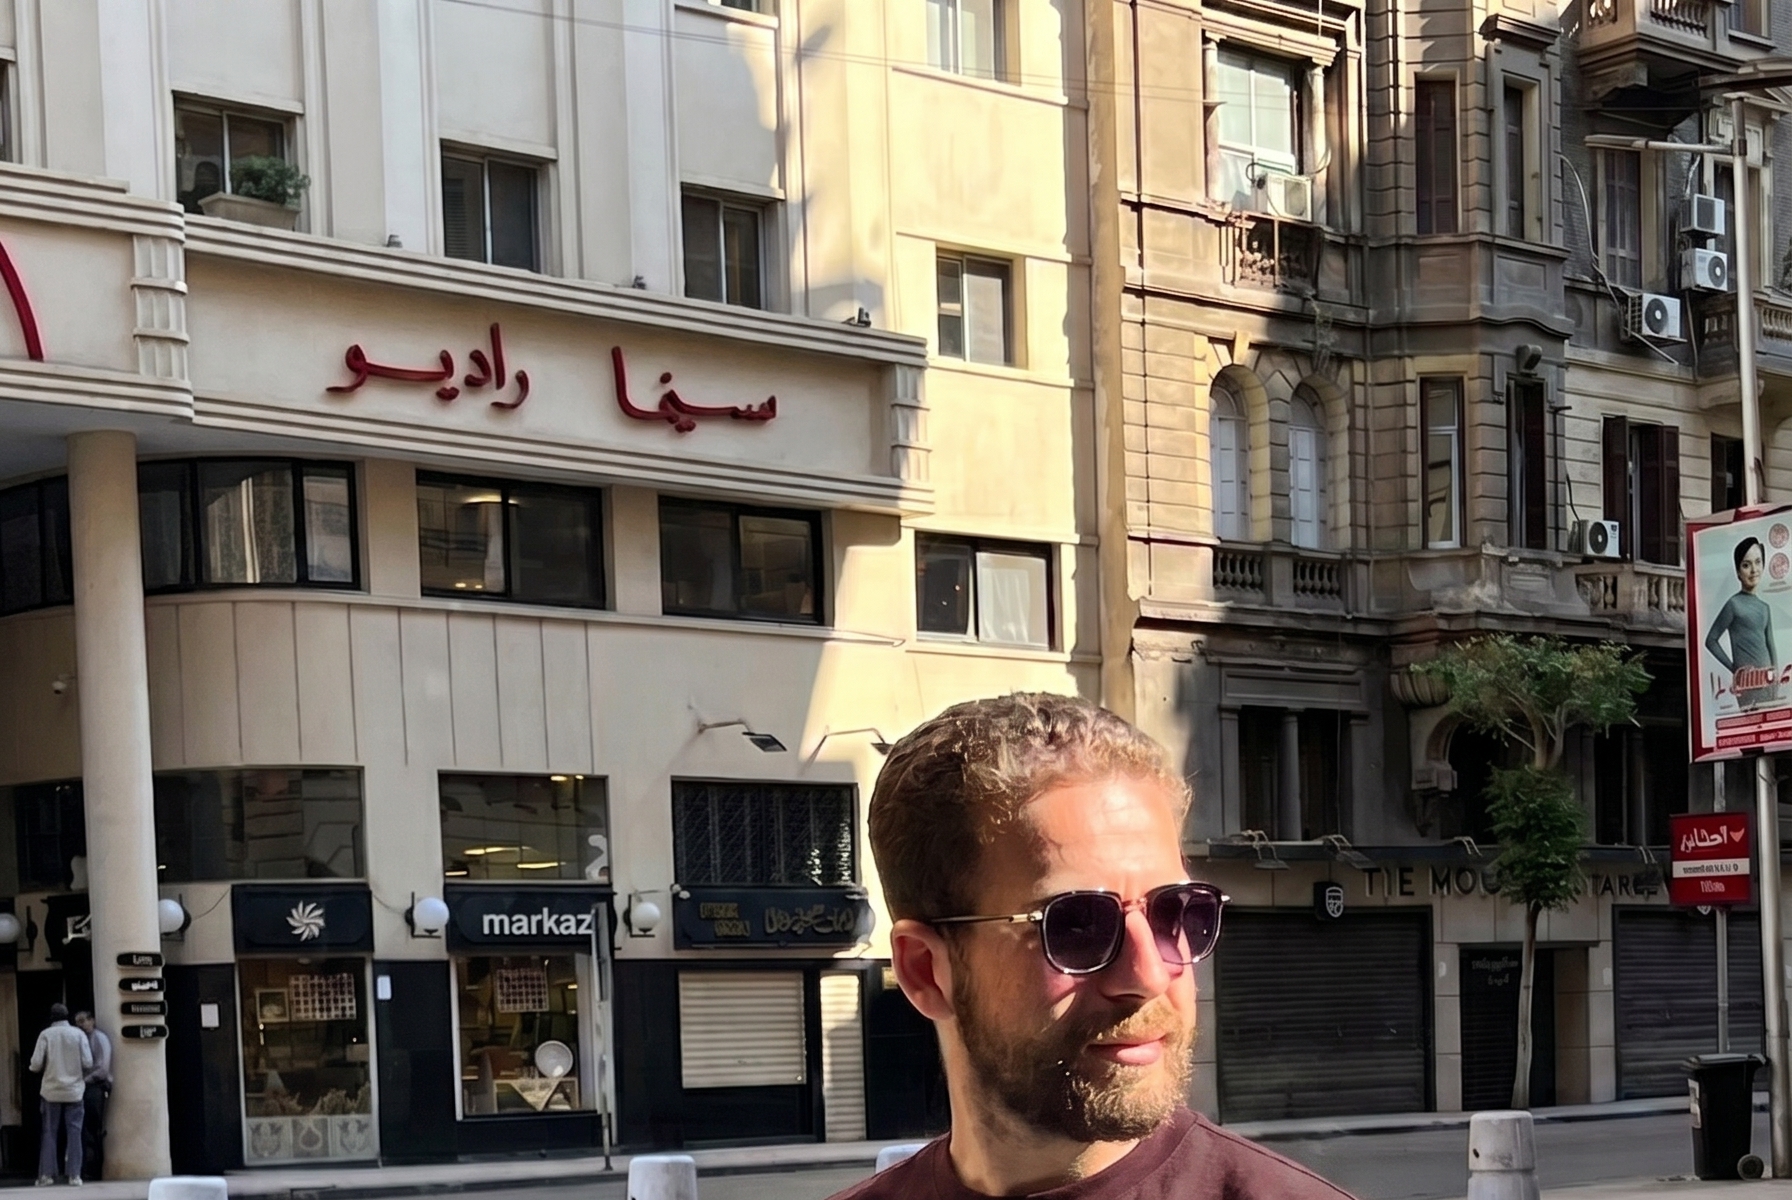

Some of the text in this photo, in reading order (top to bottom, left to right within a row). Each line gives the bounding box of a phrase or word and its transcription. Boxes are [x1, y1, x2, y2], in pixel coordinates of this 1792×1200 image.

[325, 322, 778, 434] سينما راديو
[482, 907, 594, 936] markaz
